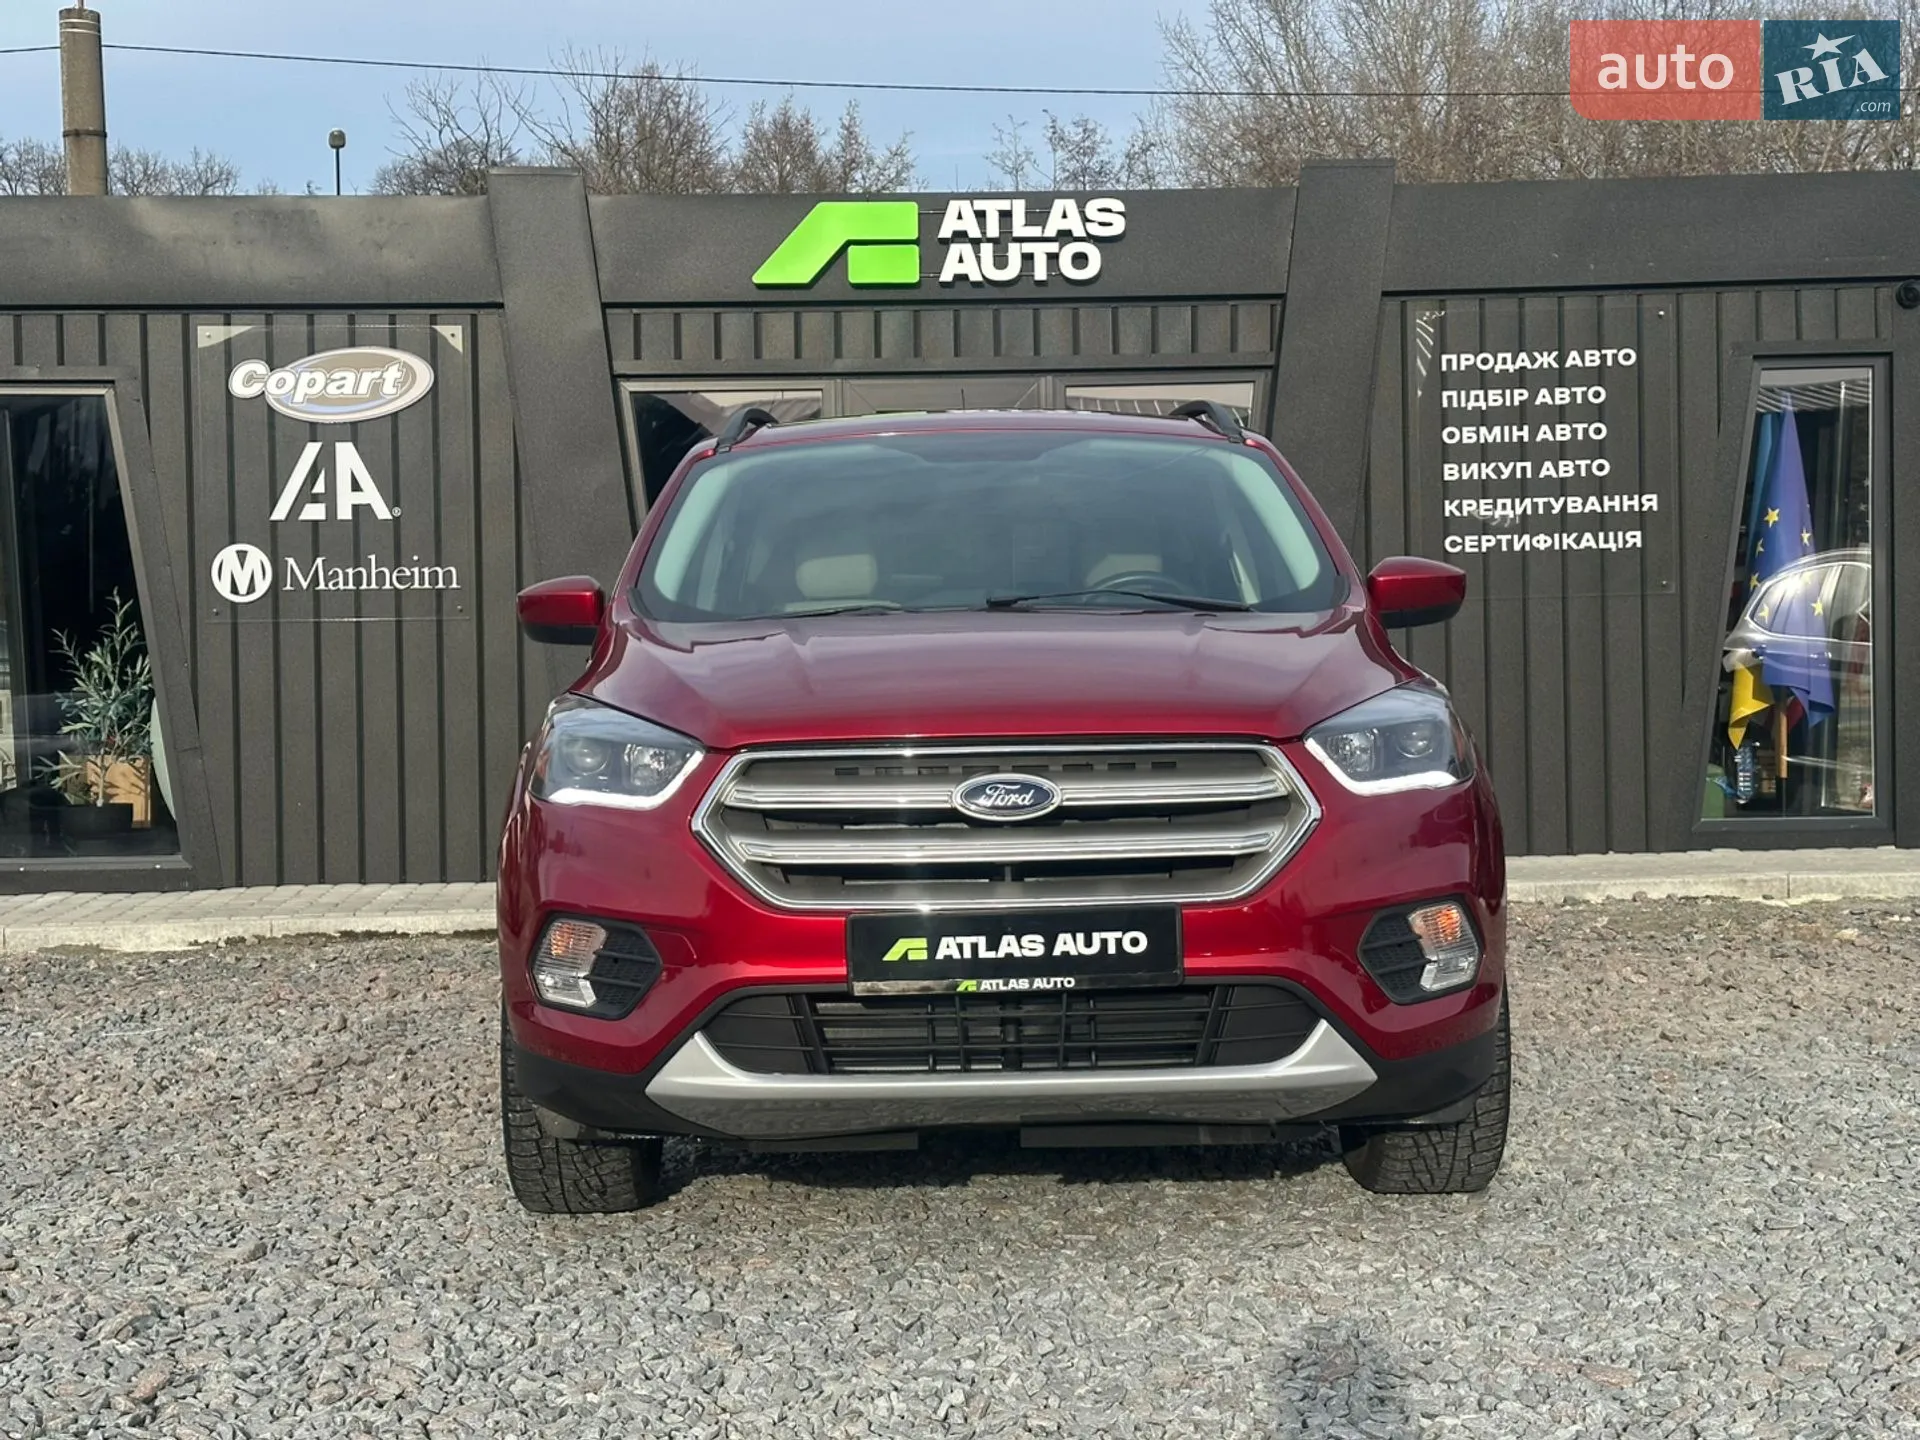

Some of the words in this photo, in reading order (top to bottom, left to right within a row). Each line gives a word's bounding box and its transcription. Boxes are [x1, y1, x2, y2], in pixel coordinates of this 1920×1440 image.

[937, 197, 1126, 239] ATLAS
[937, 242, 1102, 282] AUTO
[1441, 350, 1560, 373] ПРОДАЖ
[1564, 348, 1637, 368] АВТО
[229, 359, 404, 405] Copart
[1441, 388, 1530, 411] ПІДБІР
[1534, 385, 1607, 406] АВТО
[1441, 424, 1530, 445] ОБМІН
[1535, 422, 1608, 442] АВТО
[1443, 461, 1533, 481] ВИКУП
[1538, 458, 1611, 479] АВТО
[1444, 494, 1659, 518] КРЕДИТУВАННЯ
[1444, 531, 1642, 553] СЕРТИФІКАЦІЯ
[282, 554, 461, 591] Manheim
[977, 783, 1035, 808] Ford
[935, 935, 1045, 960] ATLAS
[1052, 931, 1148, 957] AUTO
[980, 978, 1030, 991] ATLAS
[1032, 977, 1076, 990] AUTO
